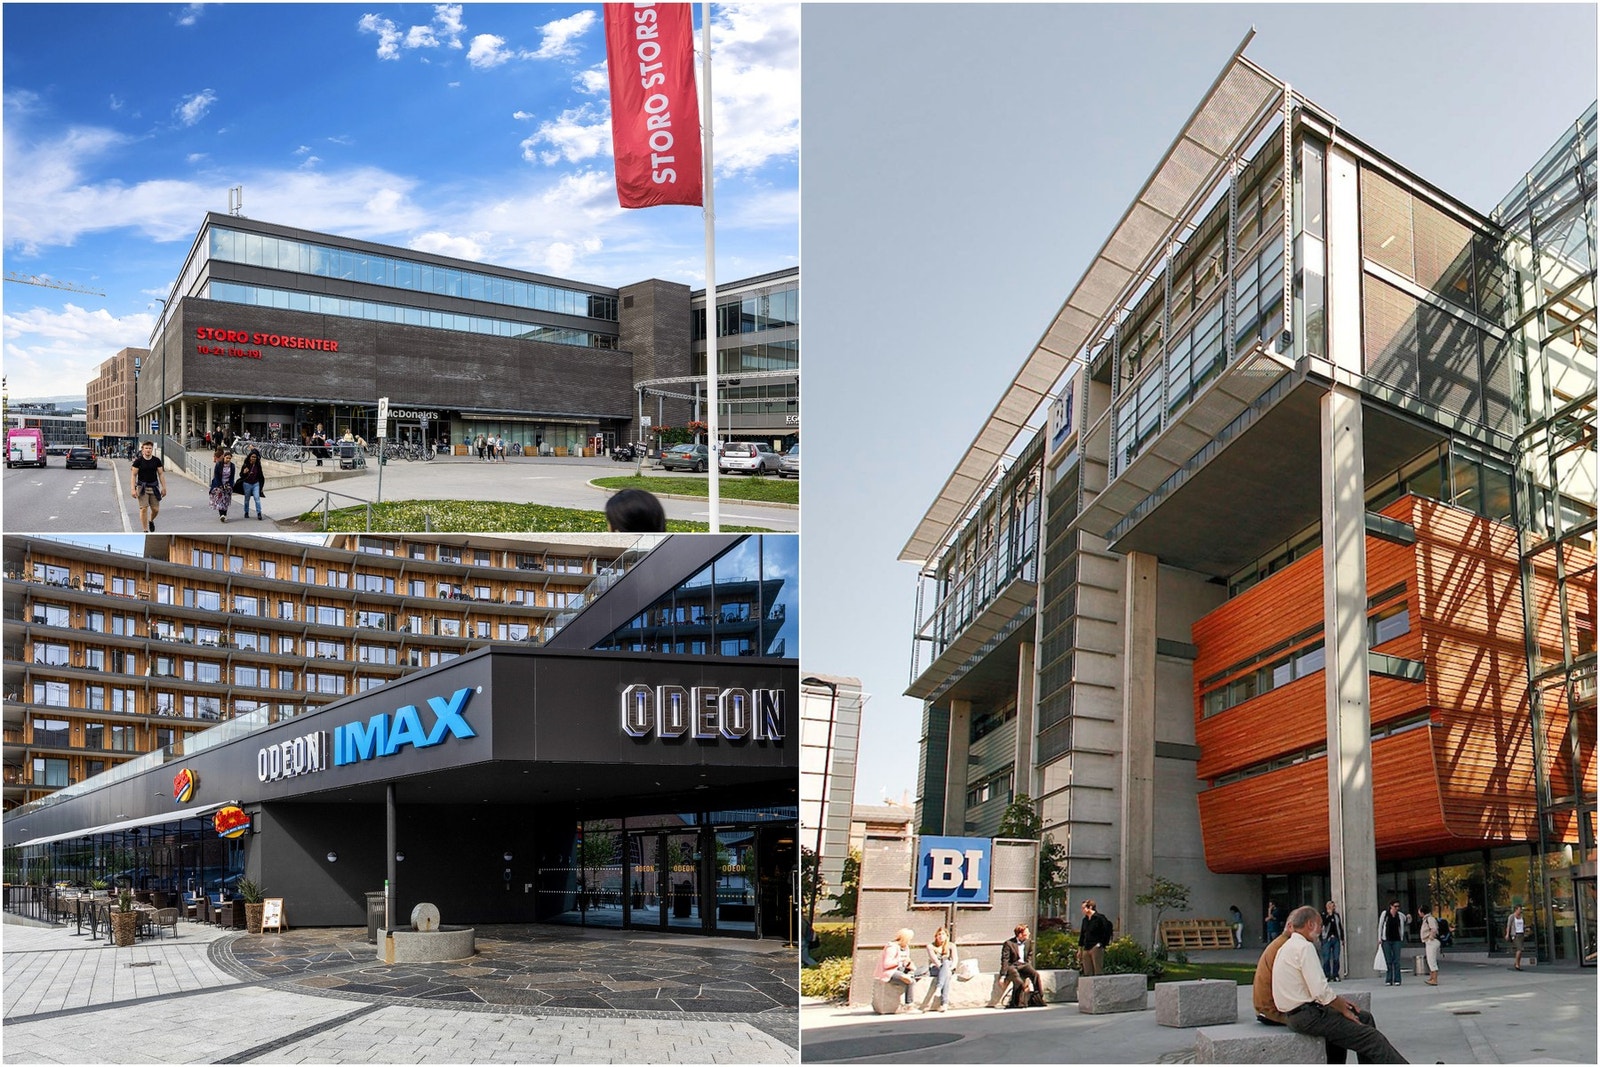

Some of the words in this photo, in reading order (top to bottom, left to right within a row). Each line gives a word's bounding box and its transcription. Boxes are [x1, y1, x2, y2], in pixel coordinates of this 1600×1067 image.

[644, 94, 677, 184] STORO
[196, 326, 249, 343] STORO
[253, 331, 339, 352] STORSENTER
[196, 345, 225, 356] 10-21
[380, 401, 386, 417] P
[386, 409, 439, 419] McDonald's
[621, 684, 786, 741] ODEON
[257, 731, 321, 783] ODEON
[334, 687, 475, 766] IMAX
[673, 864, 696, 872] ODEON
[722, 864, 746, 872] ODEON
[928, 848, 983, 890] BI
